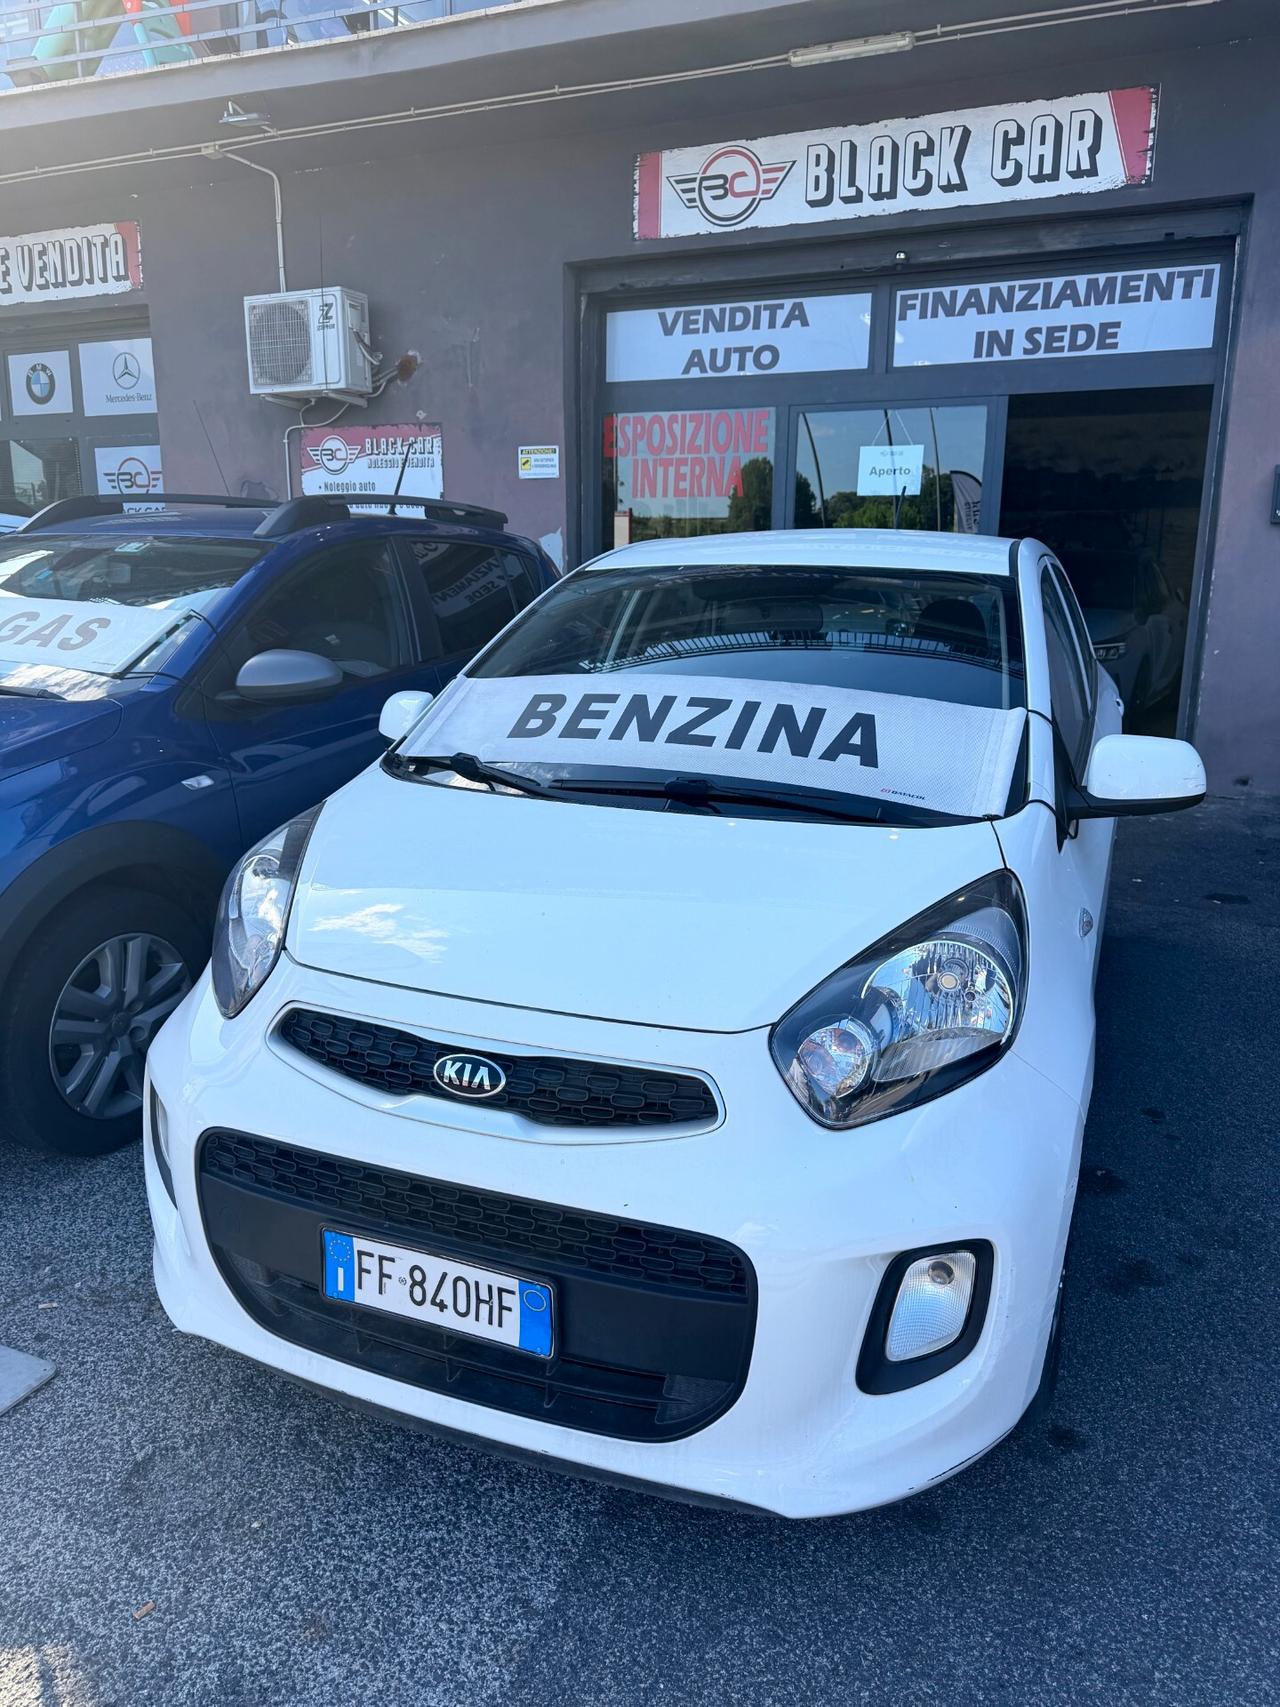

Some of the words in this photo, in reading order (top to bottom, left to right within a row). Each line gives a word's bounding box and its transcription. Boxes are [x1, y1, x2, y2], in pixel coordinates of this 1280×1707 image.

[805, 125, 971, 208] BLACK
[991, 109, 1103, 187] CAR
[0, 247, 13, 294] E
[16, 233, 129, 292] VENDITA
[898, 268, 1214, 321] FINANZIAMENTI
[657, 301, 809, 337] VENDITA
[974, 329, 1014, 358] IN
[1023, 321, 1121, 355] SEDE
[682, 345, 780, 375] AUTO
[105, 393, 152, 403] Mercedes-Benz
[365, 437, 404, 455] BLACK
[409, 437, 434, 455] CAR
[604, 410, 769, 458] ESPOSIZIONE
[324, 481, 357, 492] Noleggio
[358, 481, 376, 491] auto
[632, 456, 744, 498] INTERNA
[869, 467, 911, 477] Aperto
[0, 611, 111, 651] GAS
[507, 693, 879, 768] BENZINA
[443, 1060, 491, 1091] KIA
[357, 1249, 396, 1296] FF
[408, 1264, 517, 1328] 840HF
